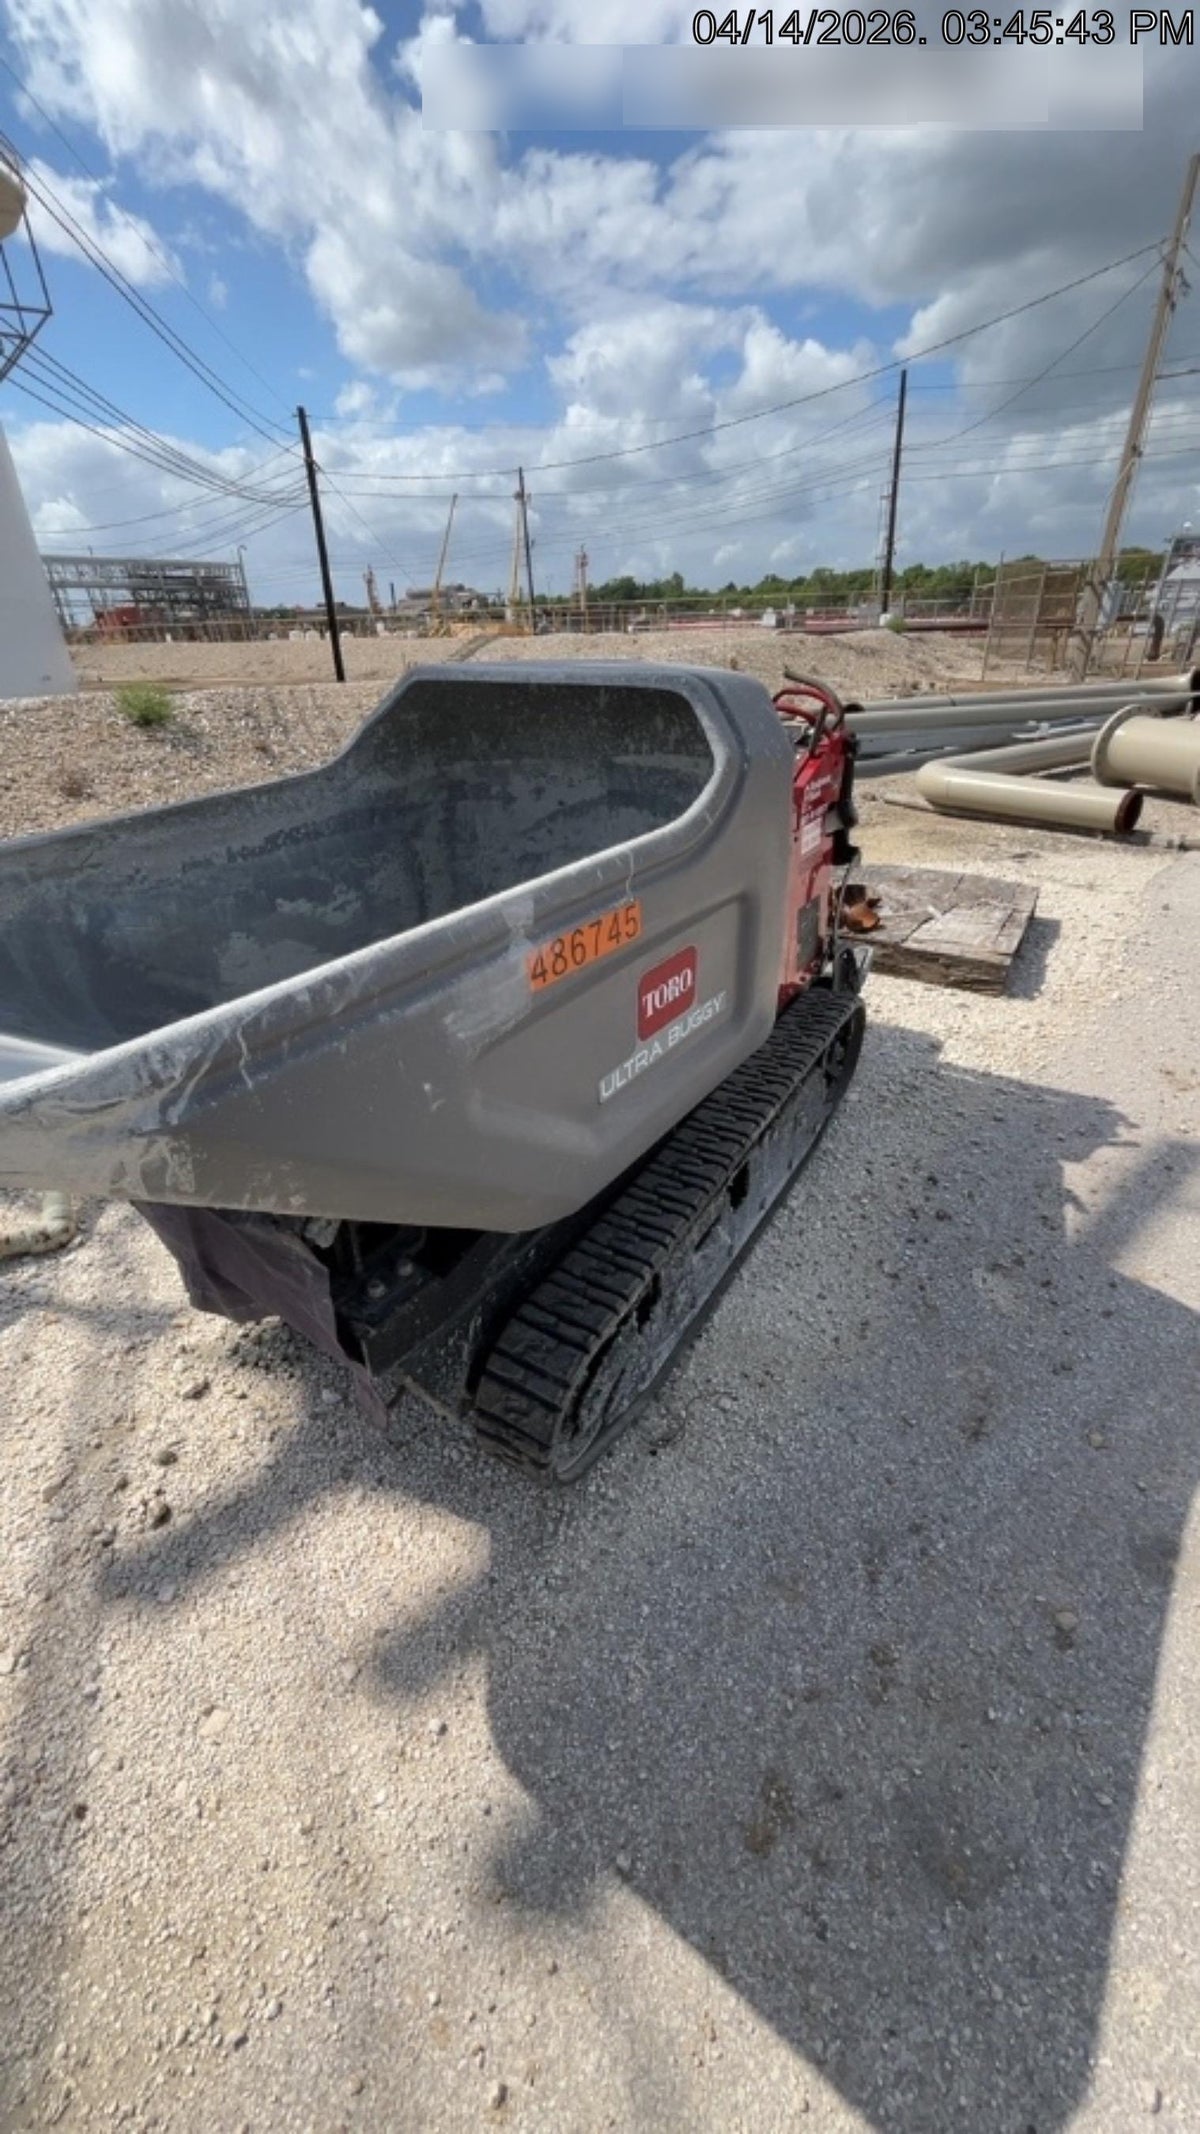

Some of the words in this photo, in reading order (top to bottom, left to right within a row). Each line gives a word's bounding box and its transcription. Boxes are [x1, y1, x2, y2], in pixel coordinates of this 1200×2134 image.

[531, 905, 639, 983] 486745
[642, 968, 692, 1018] TORO
[601, 1041, 663, 1098] ULTRA
[668, 998, 721, 1047] BUGGY
